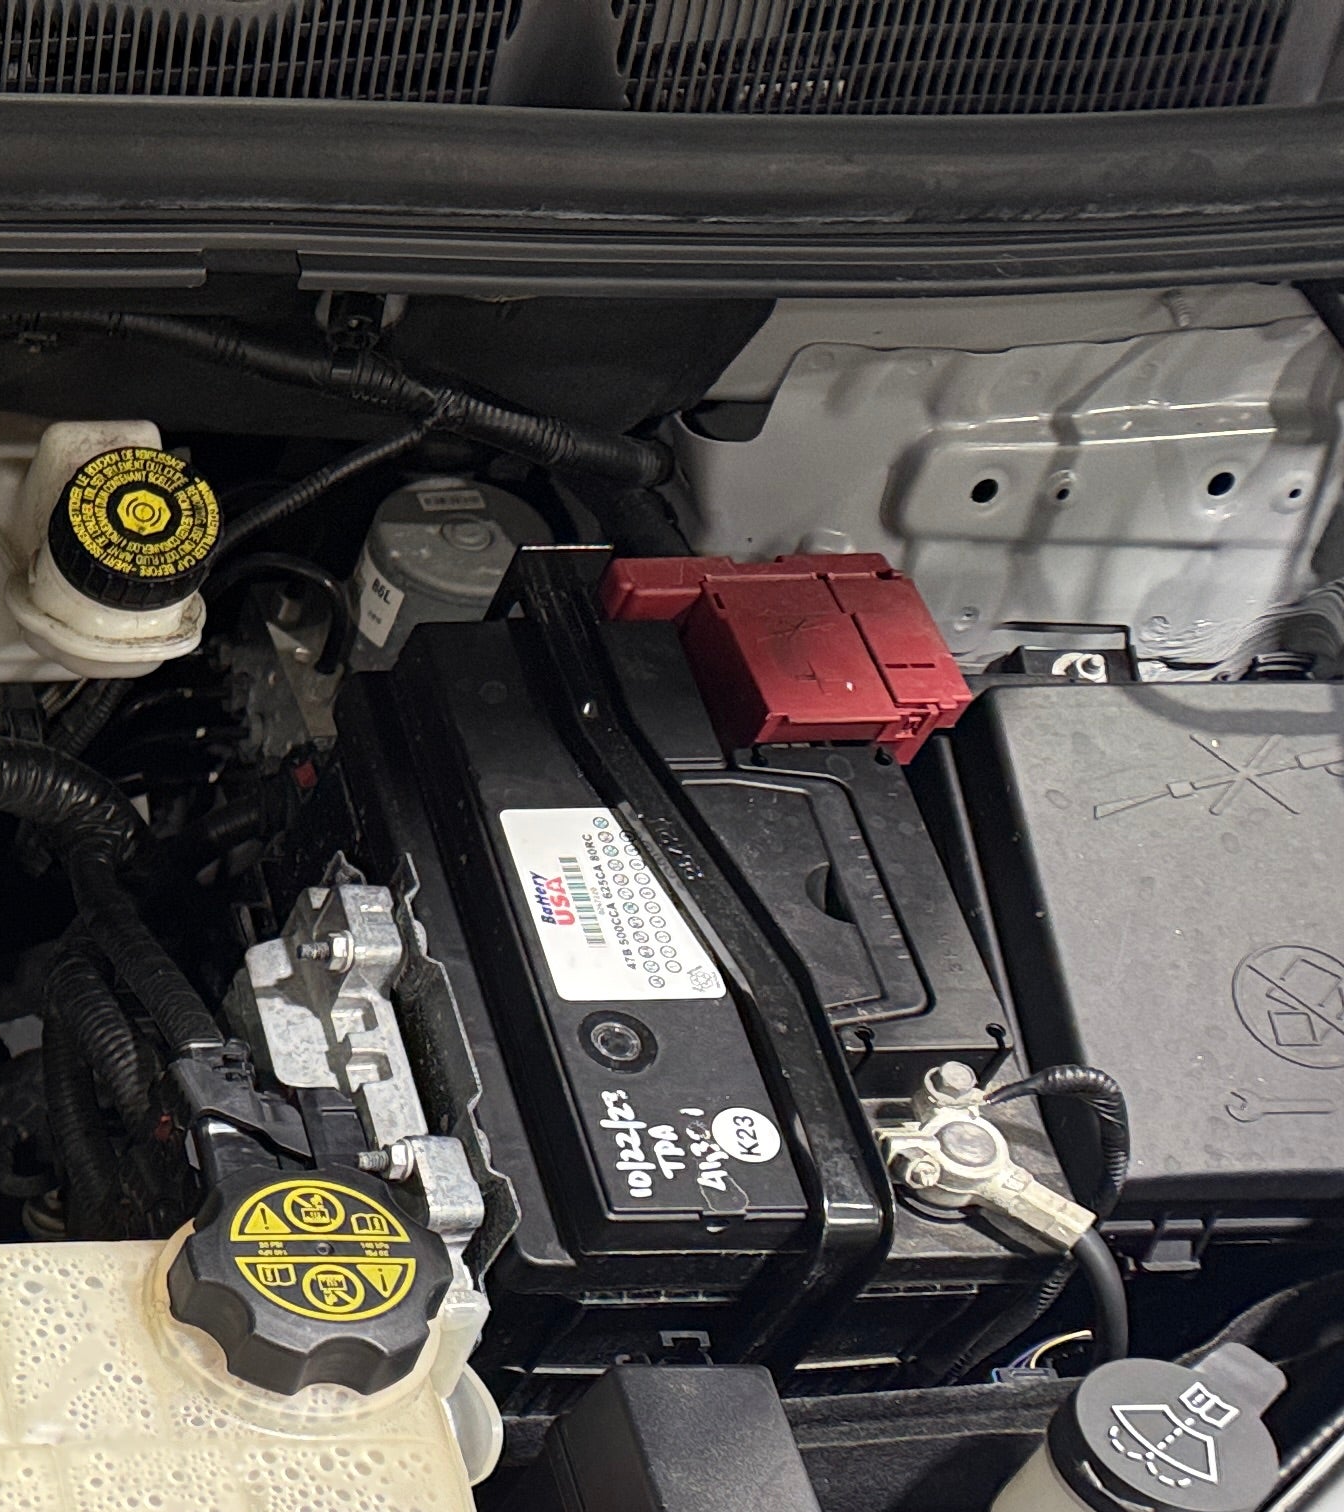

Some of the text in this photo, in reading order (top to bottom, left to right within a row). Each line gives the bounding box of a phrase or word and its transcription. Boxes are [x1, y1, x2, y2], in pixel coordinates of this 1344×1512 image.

[177, 555, 195, 571] CAP
[582, 834, 599, 861] 80RC
[529, 871, 557, 925] Battery
[545, 877, 575, 925] USA
[592, 865, 612, 898] 625CA
[606, 903, 629, 944] 500CCA
[733, 1116, 761, 1156] K23
